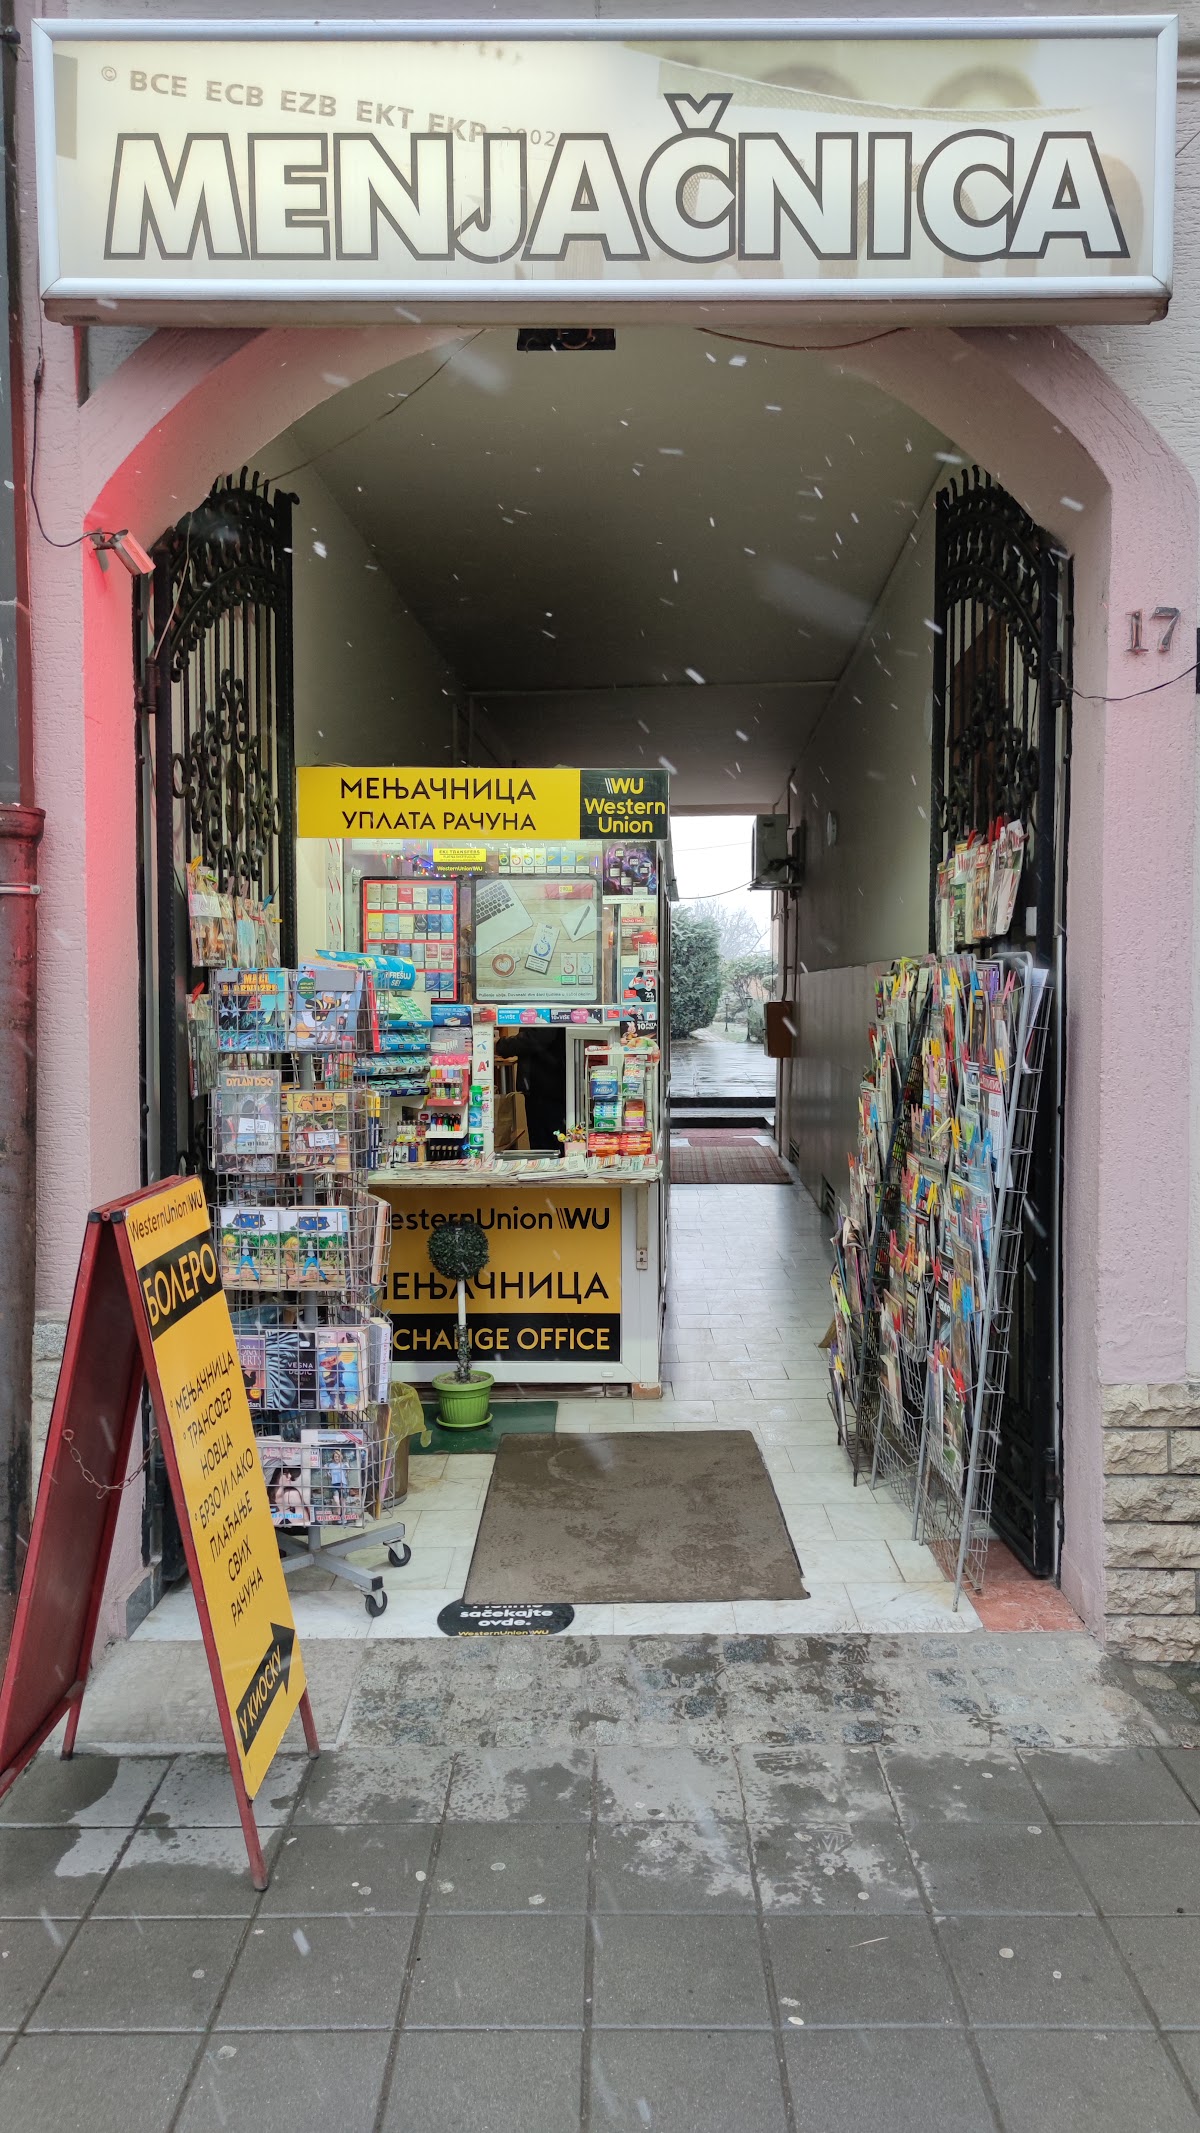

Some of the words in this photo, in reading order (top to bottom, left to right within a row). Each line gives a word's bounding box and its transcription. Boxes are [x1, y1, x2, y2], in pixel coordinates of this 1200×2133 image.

[129, 70, 188, 97] BCE
[206, 81, 264, 107] ECB
[280, 90, 337, 117] EZB
[356, 100, 414, 130] EKT
[104, 93, 1131, 264] MENJAČNICA
[1126, 606, 1180, 653] 17
[340, 777, 537, 804] МЕЊАЧНИЦА
[584, 797, 667, 815] Western
[604, 777, 645, 794] WU
[341, 811, 435, 830] УПЛАТА
[443, 812, 537, 831] РАЧУНА
[598, 816, 654, 833] Union
[226, 1077, 253, 1087] DYLAN
[255, 1077, 274, 1087] DOG
[128, 1199, 188, 1242] WesternUnion
[187, 1190, 204, 1213] WU
[391, 1206, 553, 1230] esternUnion
[556, 1207, 610, 1230] WU
[143, 1243, 217, 1326] БОЛЕРО
[384, 1271, 609, 1304] ЕЊАЧНИЦА
[393, 1327, 510, 1351] CHANGE
[516, 1327, 610, 1351] OFFICE
[175, 1350, 235, 1418] МЕЊАЧНИЦА
[287, 1361, 314, 1369] VESNA
[187, 1387, 232, 1448] ТРАНСФЕР
[200, 1430, 233, 1480] НОВЦА
[198, 1485, 221, 1529] БРЗО
[220, 1477, 230, 1498] И
[231, 1447, 254, 1489] ЛАКО
[209, 1490, 253, 1562] ПЛАЋАЊЕ
[227, 1534, 252, 1581] СВИХ
[231, 1566, 263, 1627] РАЧУНА
[460, 1609, 553, 1618] sačekajte
[478, 1618, 531, 1627] ovde.
[239, 1713, 249, 1741] У
[247, 1645, 283, 1721] КИОСКУ
